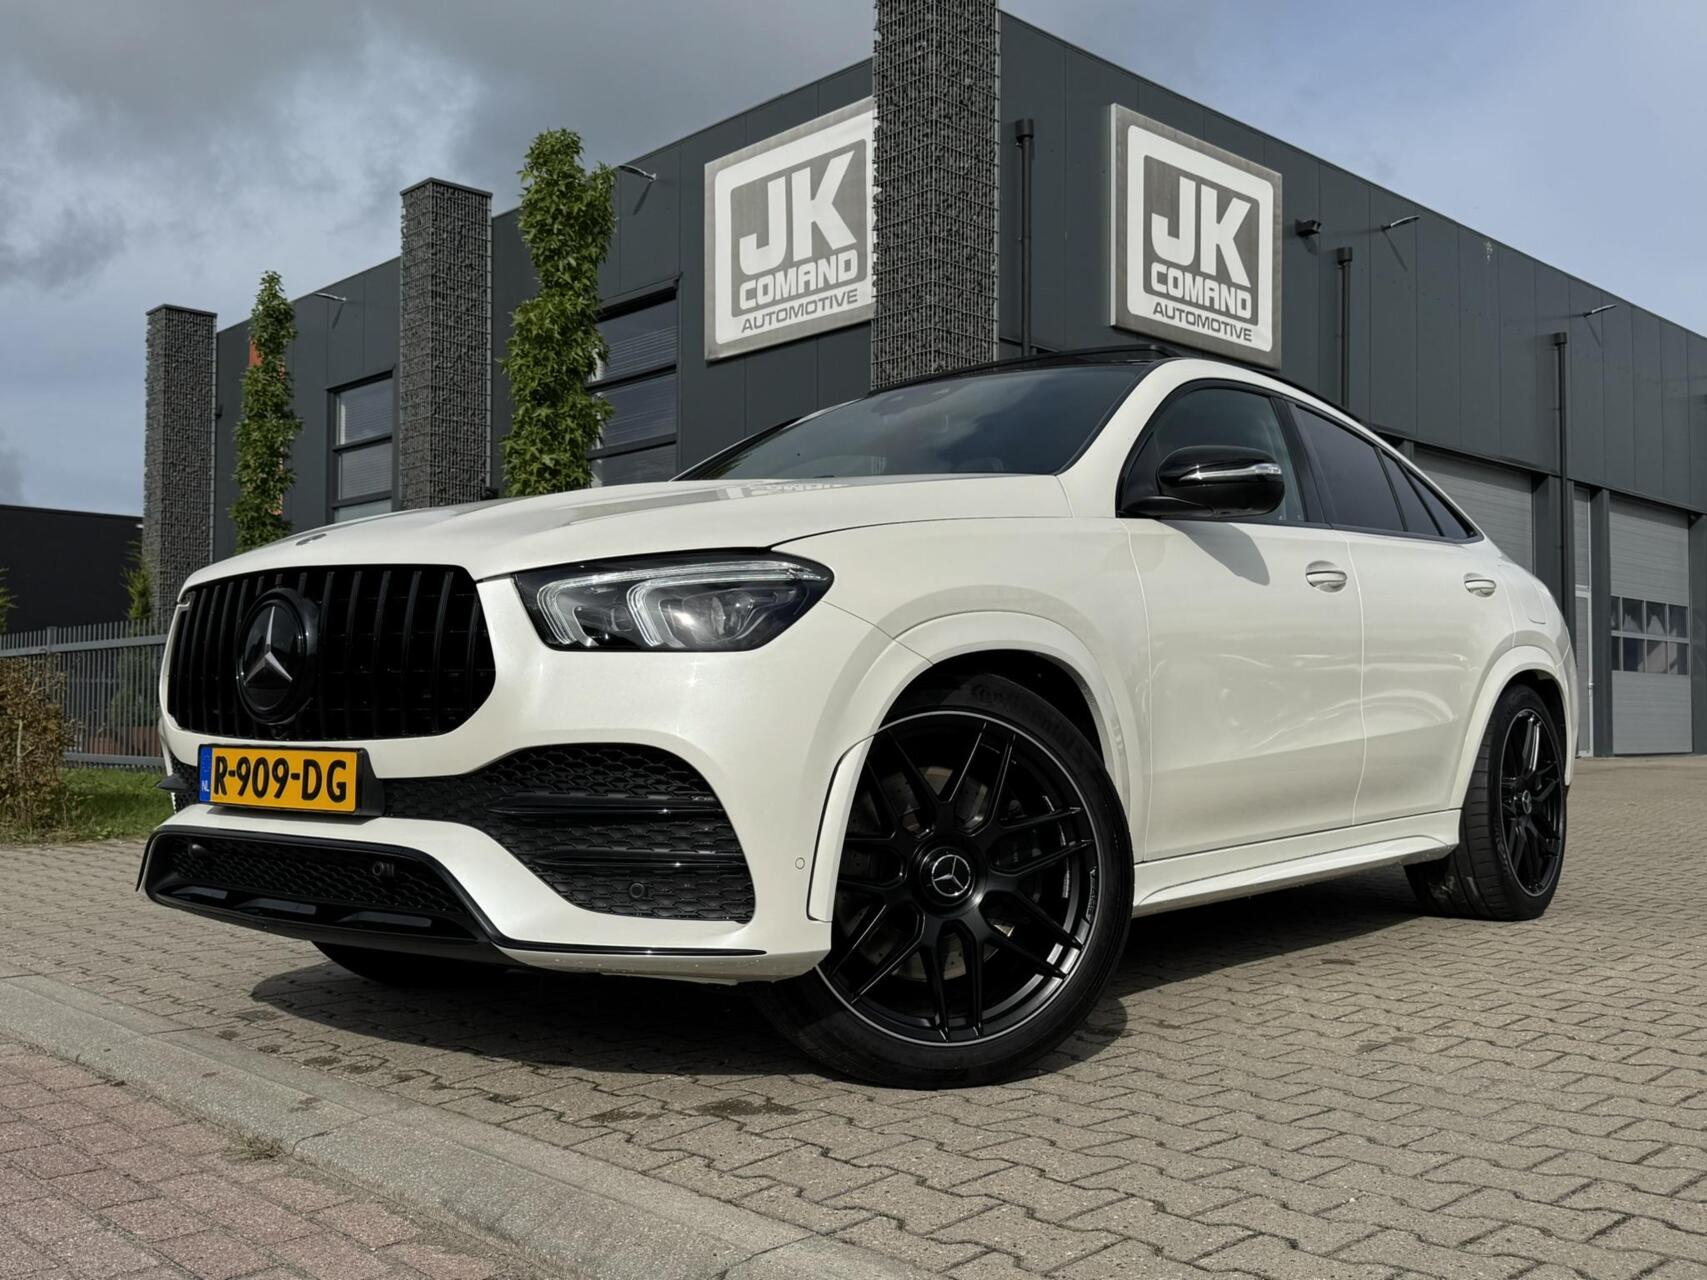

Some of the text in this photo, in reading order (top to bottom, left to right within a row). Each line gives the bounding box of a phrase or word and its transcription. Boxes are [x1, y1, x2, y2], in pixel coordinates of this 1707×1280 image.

[740, 151, 857, 275] JK
[1151, 176, 1252, 288] JK
[740, 249, 858, 310] COMAND
[1151, 262, 1252, 320] COMAND
[741, 288, 858, 333] AUTOMOTIVE
[1153, 302, 1252, 342] AUTOMOTIVE
[201, 780, 210, 792] NL
[214, 756, 347, 803] R-909-DG
